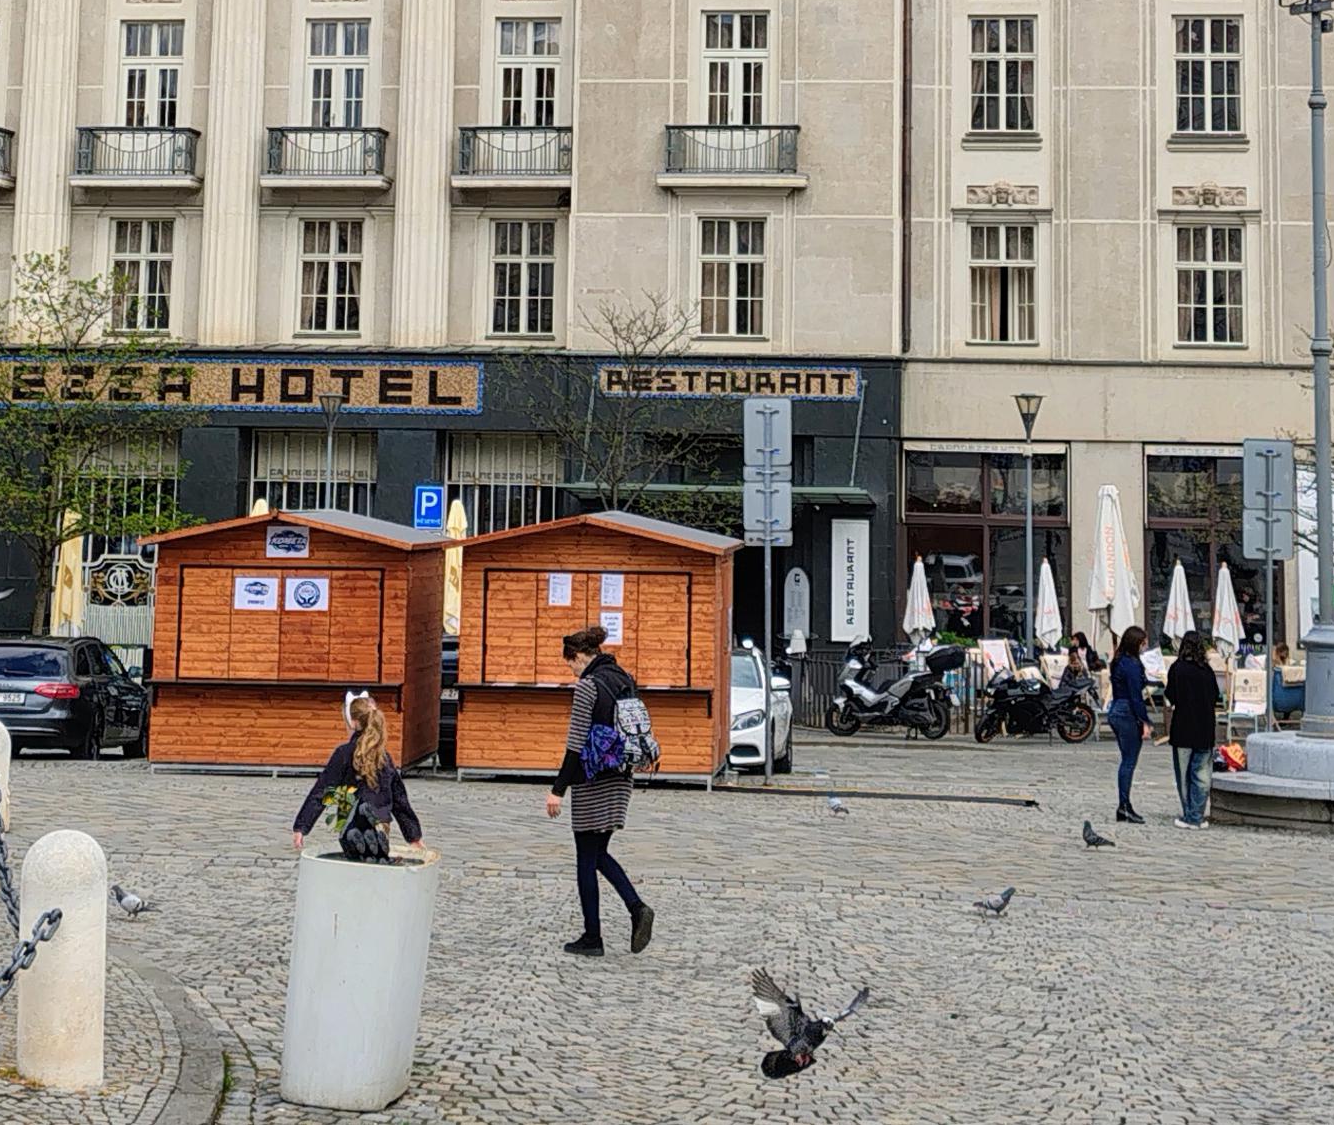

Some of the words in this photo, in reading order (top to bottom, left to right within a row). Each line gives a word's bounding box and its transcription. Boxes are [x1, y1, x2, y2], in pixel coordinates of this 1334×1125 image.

[231, 366, 463, 406] HOTEL
[604, 369, 852, 395] RESTAURANT
[421, 491, 438, 516] P
[1105, 525, 1116, 588] CHANDON
[845, 538, 855, 626] RESTAURANT
